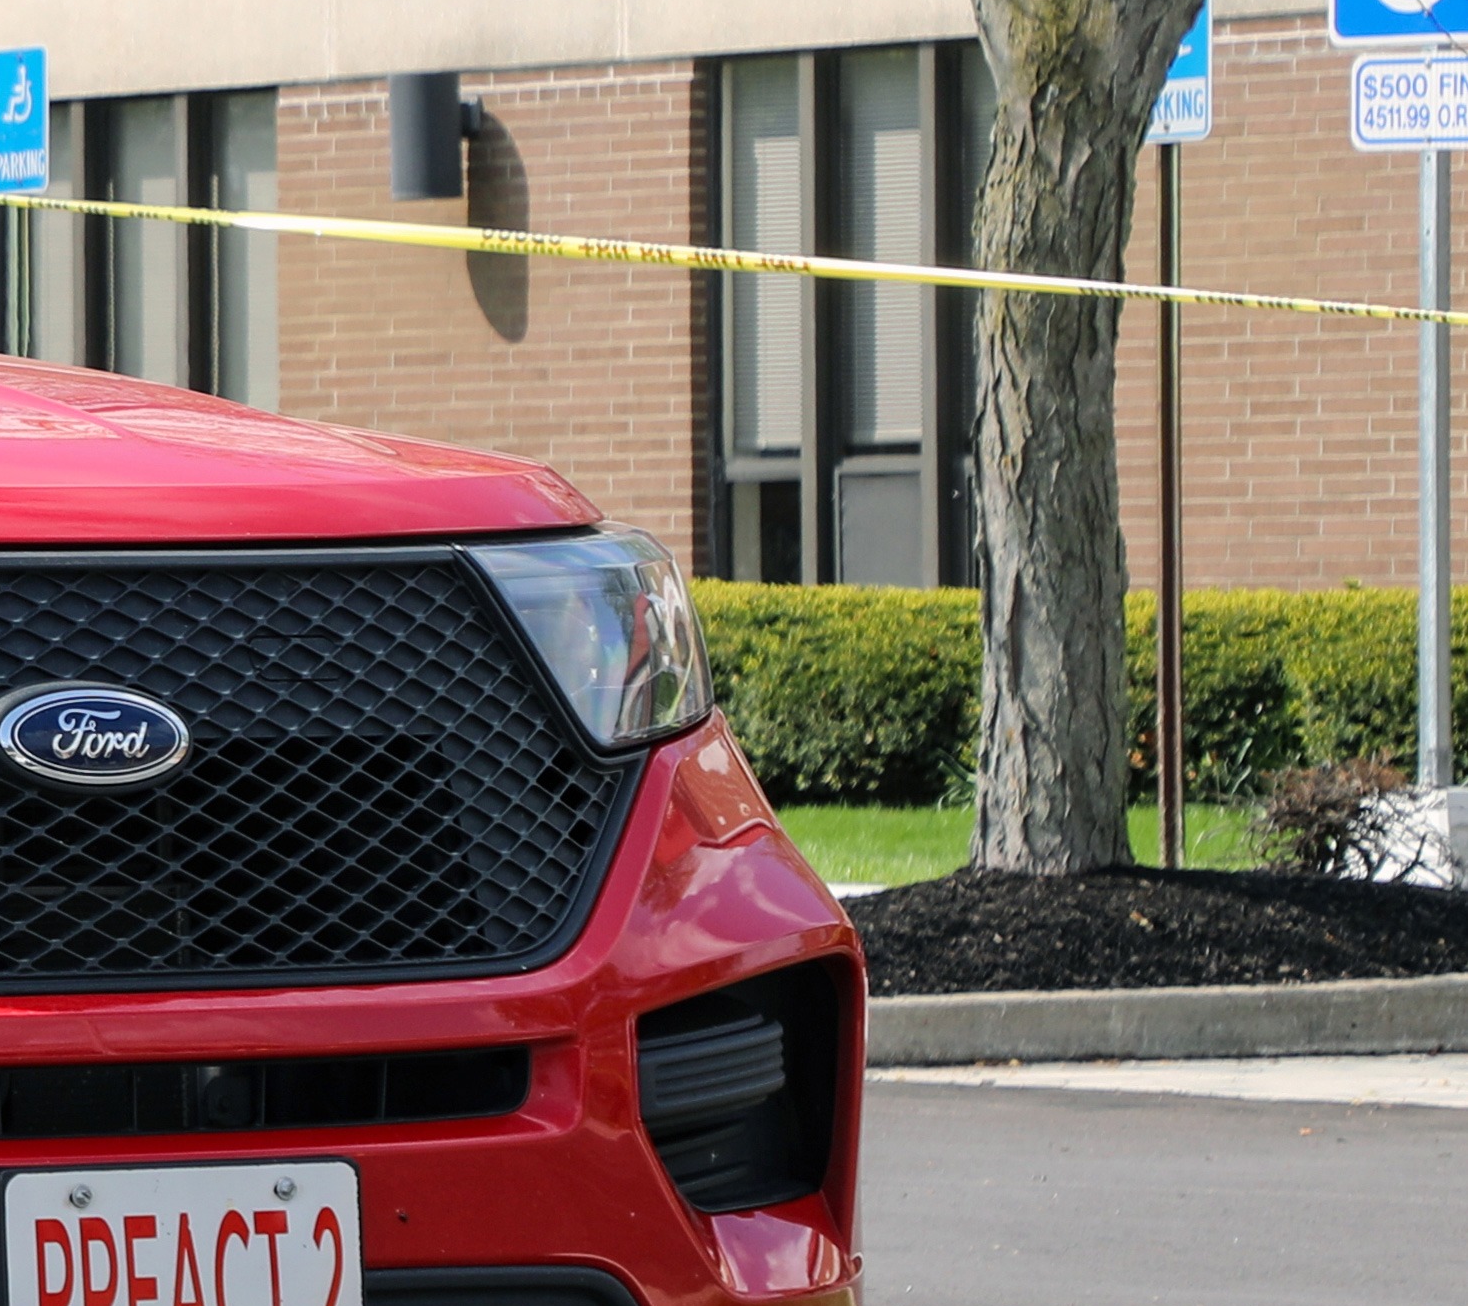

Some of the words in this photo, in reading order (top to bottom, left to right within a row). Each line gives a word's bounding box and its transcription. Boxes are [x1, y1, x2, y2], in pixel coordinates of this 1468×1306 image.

[1364, 73, 1428, 100] $500
[1151, 89, 1204, 120] RKING
[1364, 103, 1430, 129] 4511.99
[52, 708, 150, 760] Ford
